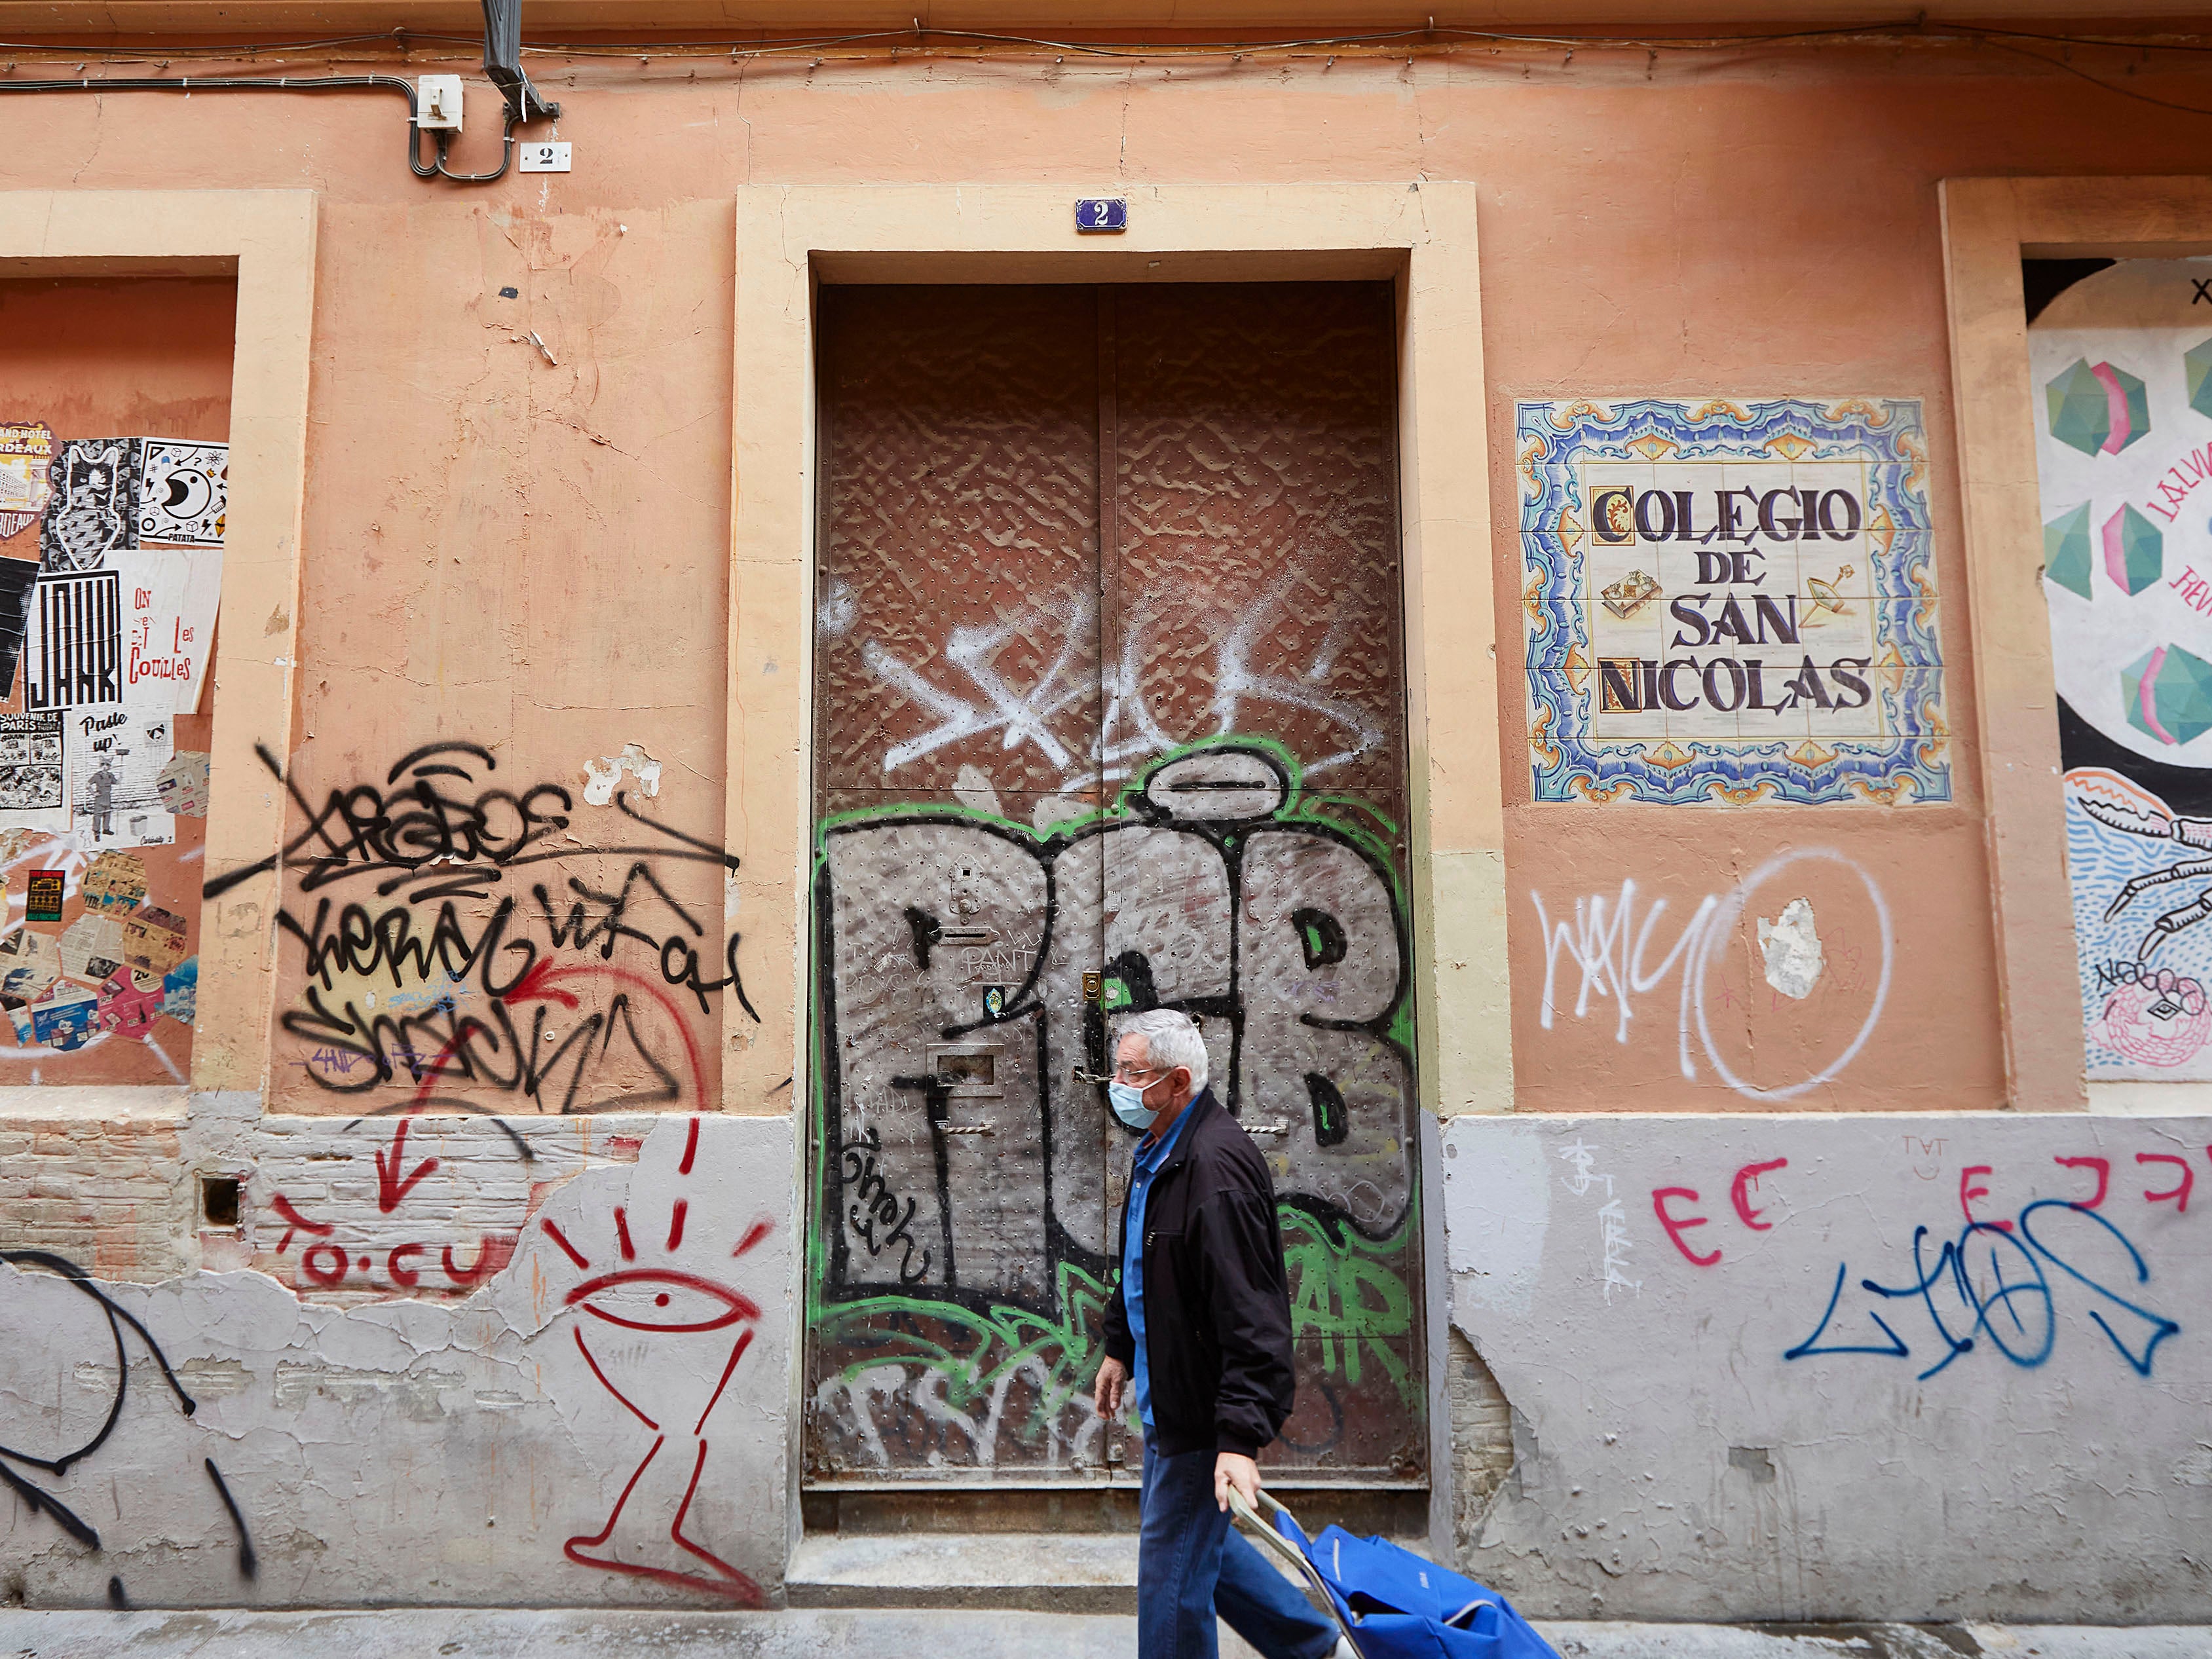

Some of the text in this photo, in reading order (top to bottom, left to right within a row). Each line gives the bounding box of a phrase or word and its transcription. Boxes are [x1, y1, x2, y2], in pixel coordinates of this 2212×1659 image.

[540, 147, 553, 164] 2
[1094, 202, 1108, 225] 2
[21, 429, 52, 439] HOTEL
[1592, 485, 1862, 546] COLEGIO
[168, 533, 195, 543] PATATA
[1693, 548, 1767, 586] DE
[1670, 592, 1801, 650] SAN
[1599, 655, 1872, 715] NICOLAS
[0, 720, 37, 731] PARiS
[47, 713, 58, 722] DE
[79, 712, 128, 736] Paste
